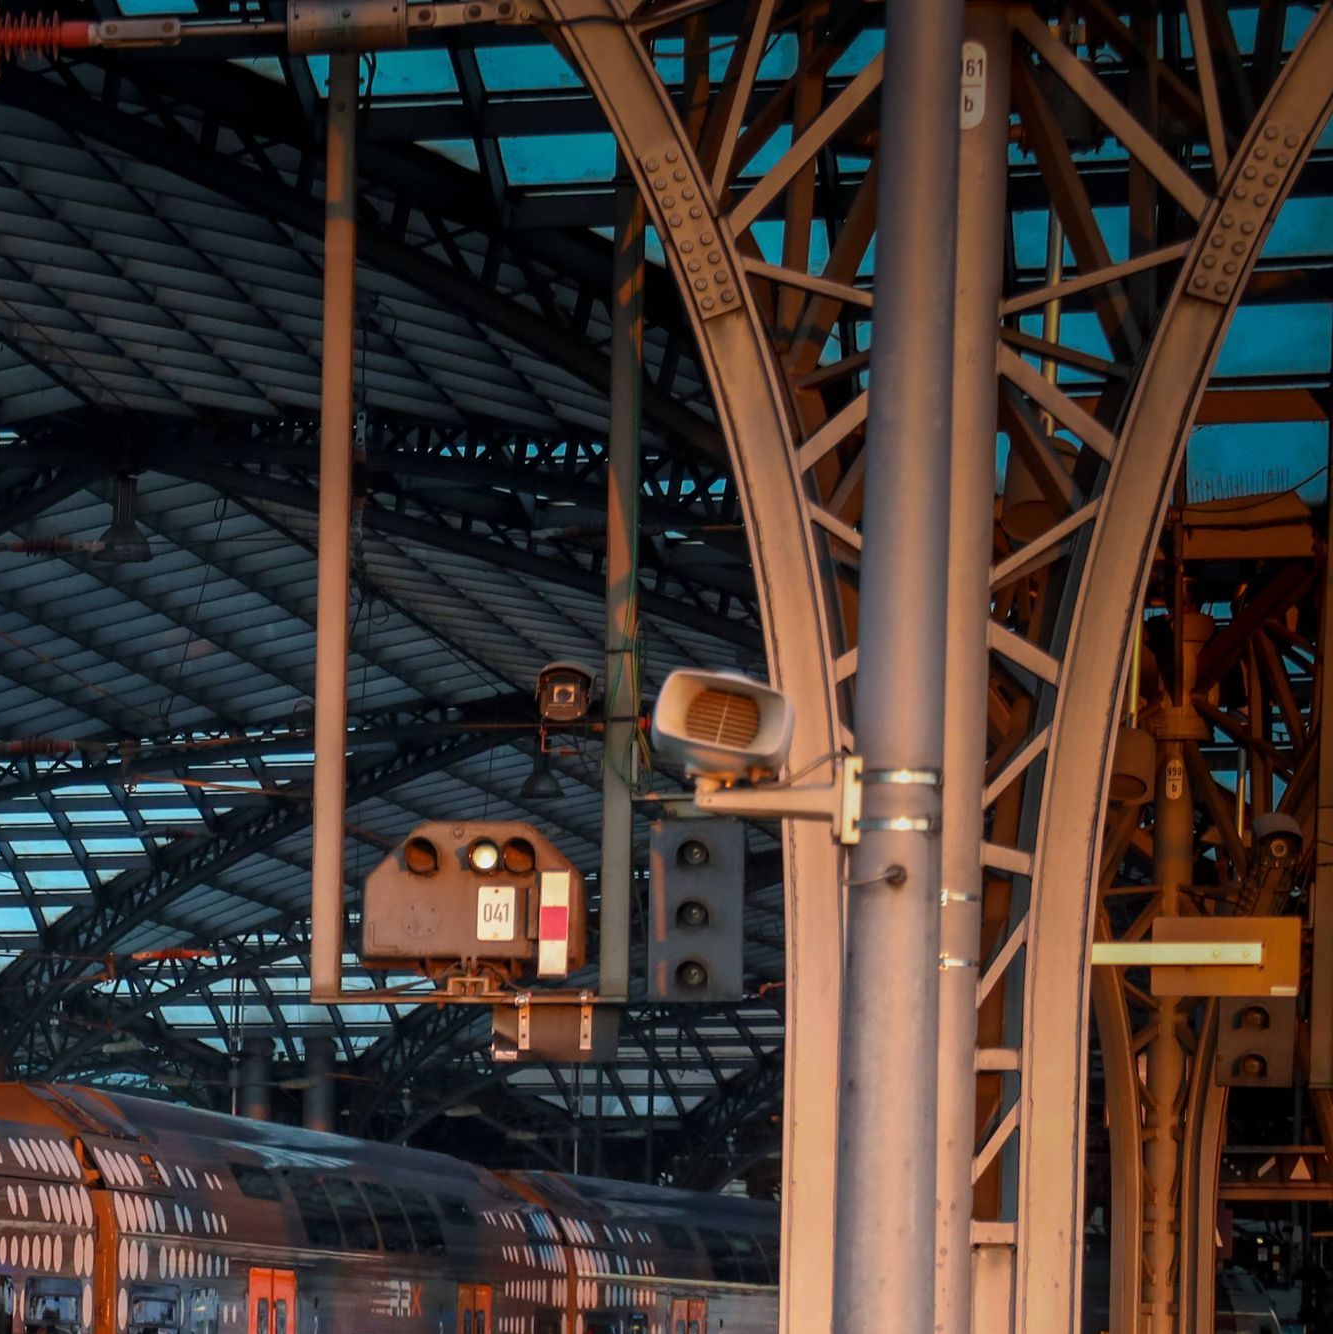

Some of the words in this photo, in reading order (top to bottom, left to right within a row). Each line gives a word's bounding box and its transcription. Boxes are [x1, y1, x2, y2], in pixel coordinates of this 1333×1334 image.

[962, 58, 984, 78] 61
[964, 95, 974, 113] b
[483, 903, 510, 923] 041
